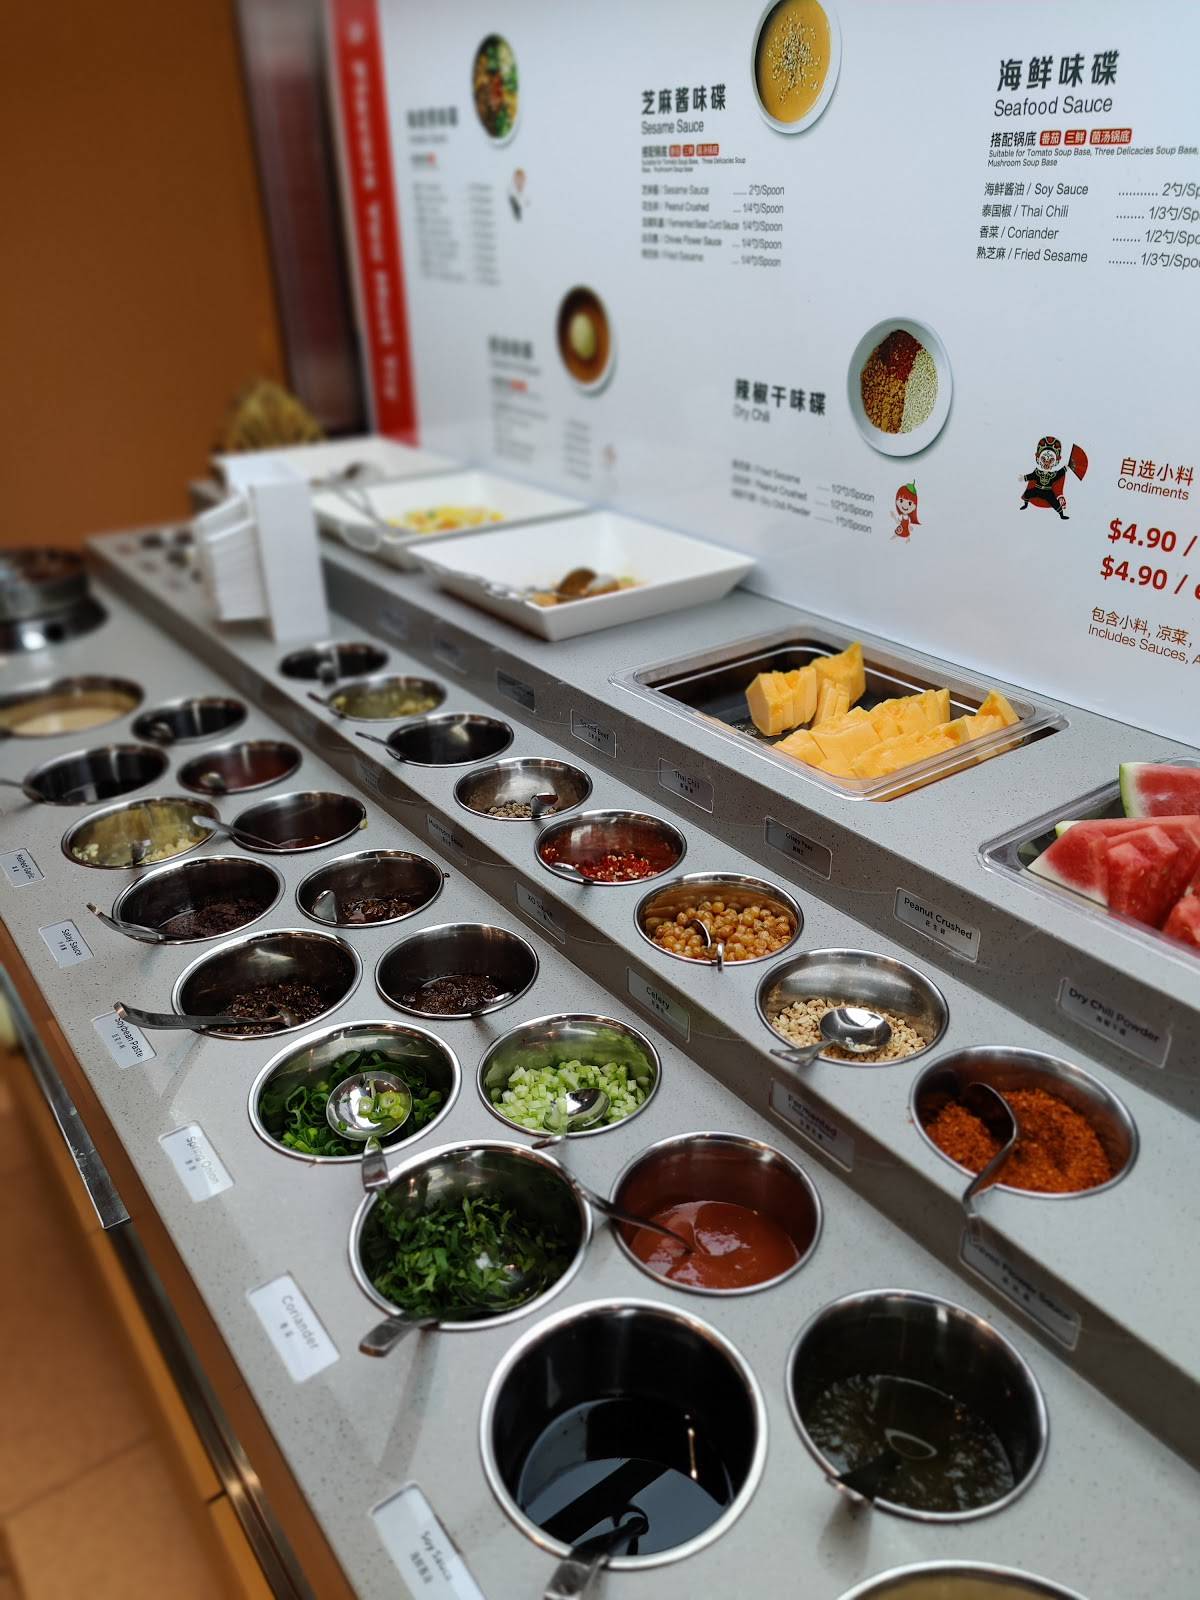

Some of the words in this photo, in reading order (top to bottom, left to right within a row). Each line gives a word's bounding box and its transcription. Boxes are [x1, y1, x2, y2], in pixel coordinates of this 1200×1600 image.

[997, 50, 1119, 91] 海鲜味碟
[641, 84, 726, 115] 芝麻酱味碟
[994, 96, 1058, 117] Seafood
[1062, 96, 1113, 114] Sauce
[677, 119, 704, 133] Sauce
[989, 149, 1014, 158] Suitable
[1015, 149, 1025, 157] for
[1027, 149, 1053, 157] Tomato
[1054, 148, 1072, 157] Soup
[1073, 148, 1092, 156] Base,
[1094, 147, 1115, 156] Three
[1116, 147, 1154, 155] Delicacies
[1155, 146, 1176, 156] Soup
[990, 131, 1037, 148] 搭配锅底
[1041, 131, 1060, 145] 番茄
[1065, 131, 1085, 145] 三鲜
[988, 159, 1021, 168] Mushroom
[1022, 159, 1040, 168] Soup
[1041, 159, 1058, 167] Base
[984, 182, 1025, 196] 海鲜酱油
[1034, 183, 1054, 198] Soy
[1056, 183, 1089, 195] Sauce
[982, 203, 1012, 218] 泰国椒
[1020, 204, 1044, 217] Thai
[1046, 204, 1069, 218] Chili
[980, 225, 1000, 239] 香菜
[1007, 226, 1060, 239] Coriander
[976, 246, 1006, 260] 熟芝麻
[1014, 247, 1041, 261] Fried
[1043, 248, 1088, 263] Sesame
[1120, 457, 1194, 487] 自选小料
[1117, 478, 1190, 501] Condiments
[1107, 517, 1177, 553] $4.90
[1100, 554, 1168, 591] $4.90
[1088, 623, 1137, 648] Includes
[1138, 637, 1189, 665] Sauces,
[904, 897, 934, 919] Peanut
[935, 914, 972, 940] Crushed
[61, 928, 74, 943] Satay
[69, 941, 82, 957] Sauce
[646, 986, 670, 1010] Celery
[1069, 987, 1088, 1005] Dry
[1116, 1013, 1160, 1043] Powder
[114, 1017, 134, 1042] Soybean
[131, 1041, 144, 1058] Paste
[281, 1294, 319, 1350] Coriander
